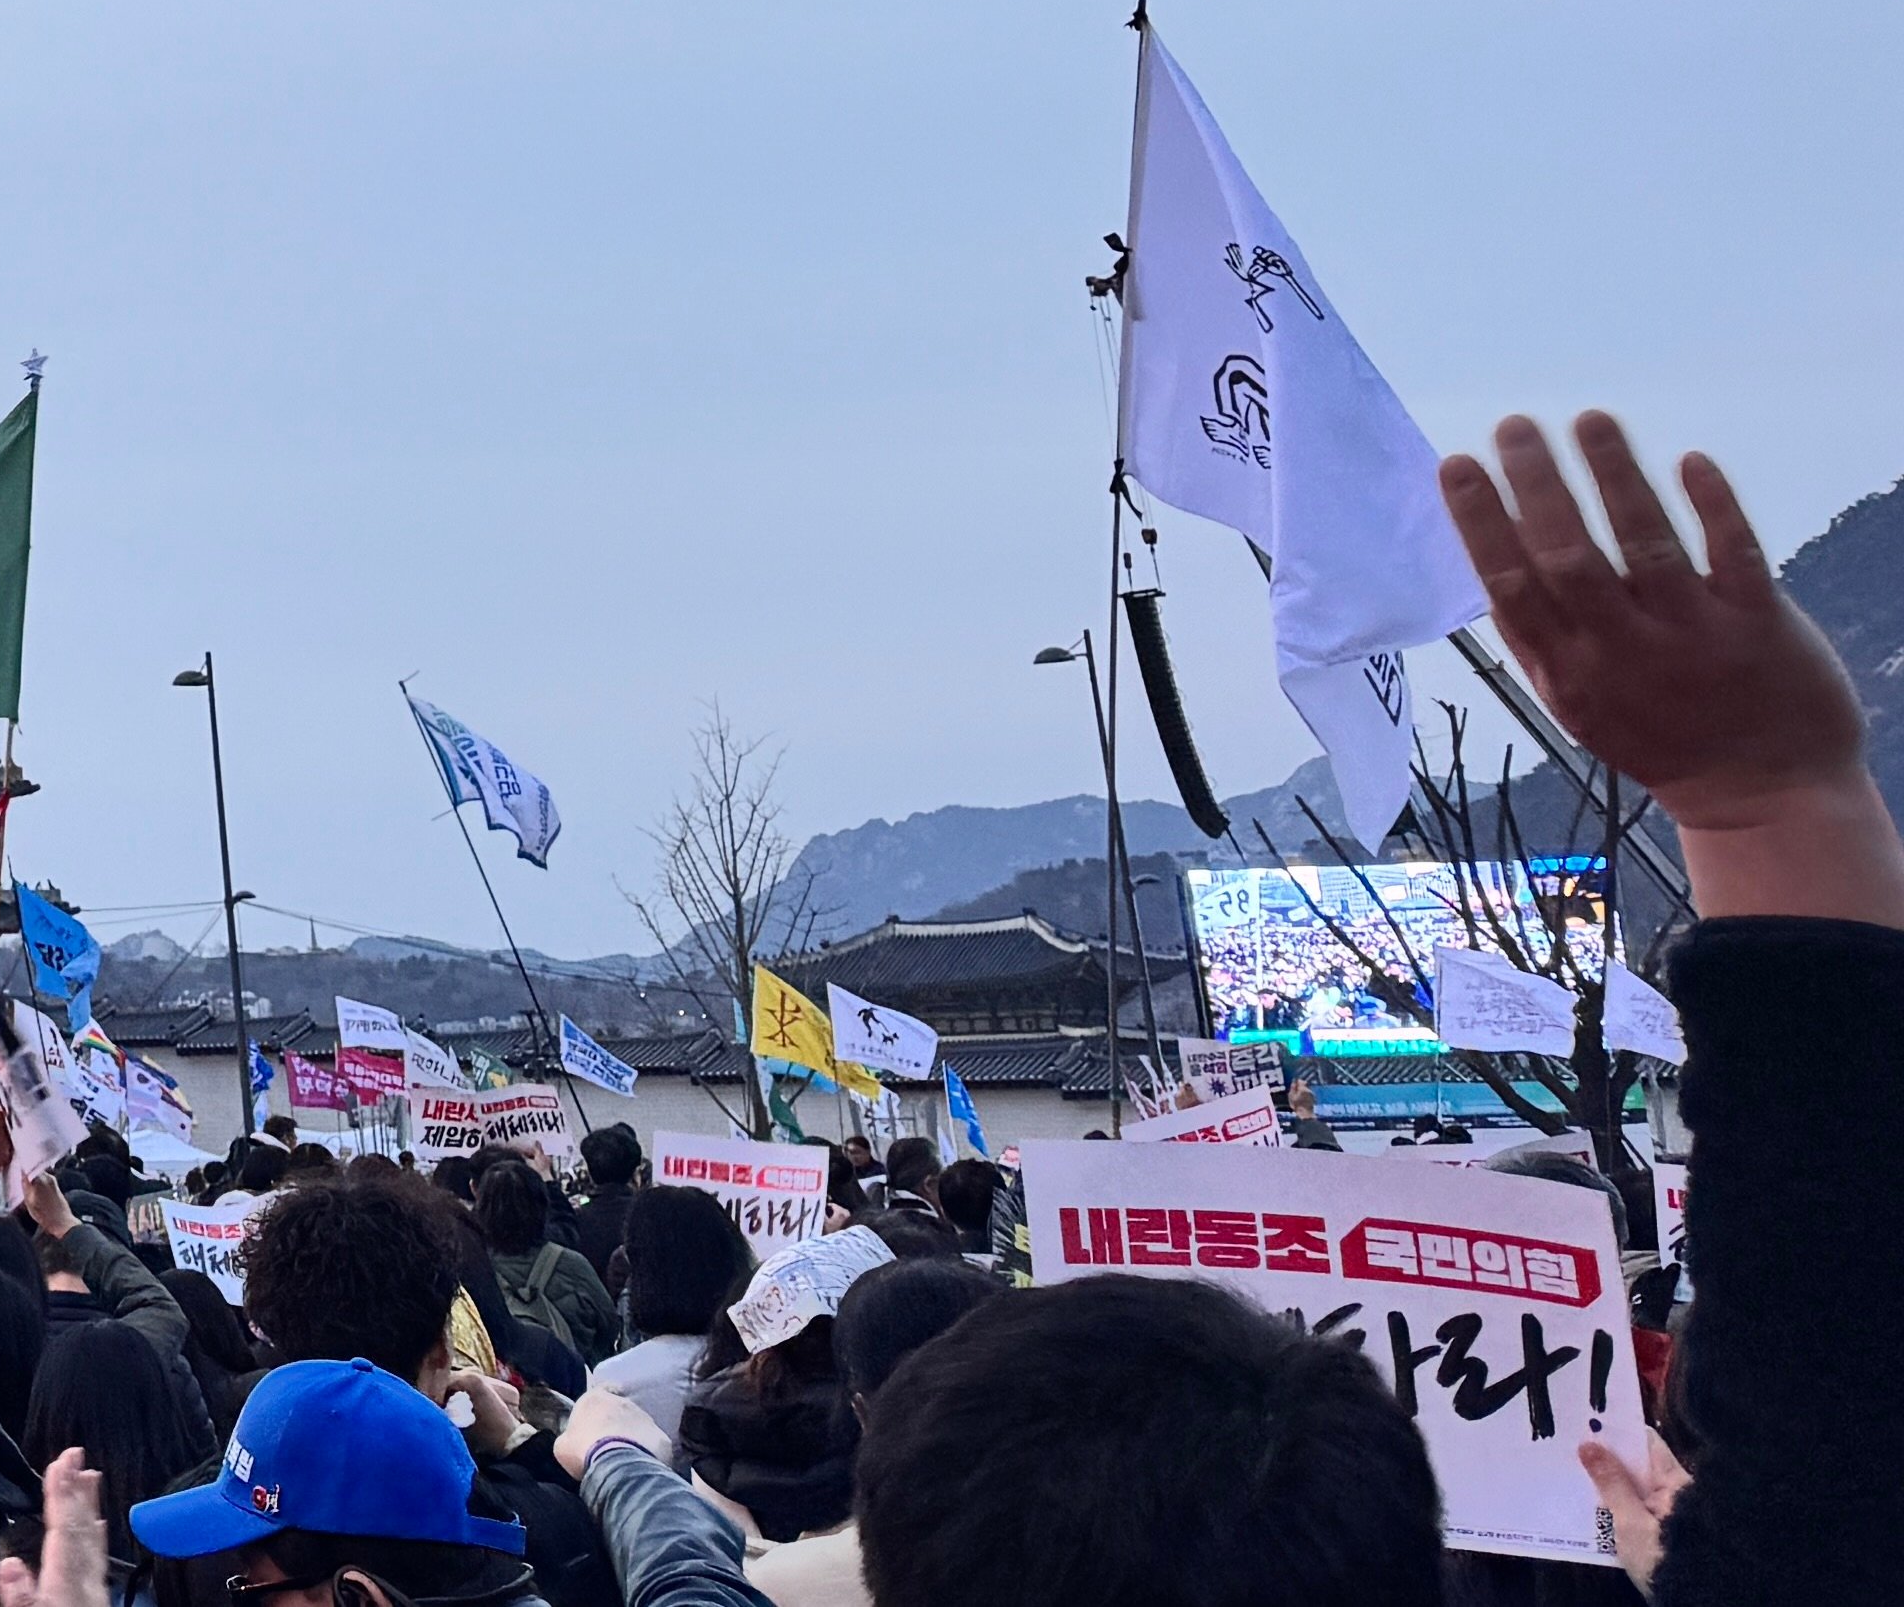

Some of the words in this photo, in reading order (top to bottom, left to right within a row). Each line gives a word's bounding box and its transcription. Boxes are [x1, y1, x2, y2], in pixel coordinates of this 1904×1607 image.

[1058, 1206, 1331, 1275] 내란동조
[1365, 1226, 1584, 1301] 국민의힘
[1283, 1302, 1616, 1444] 하라!
